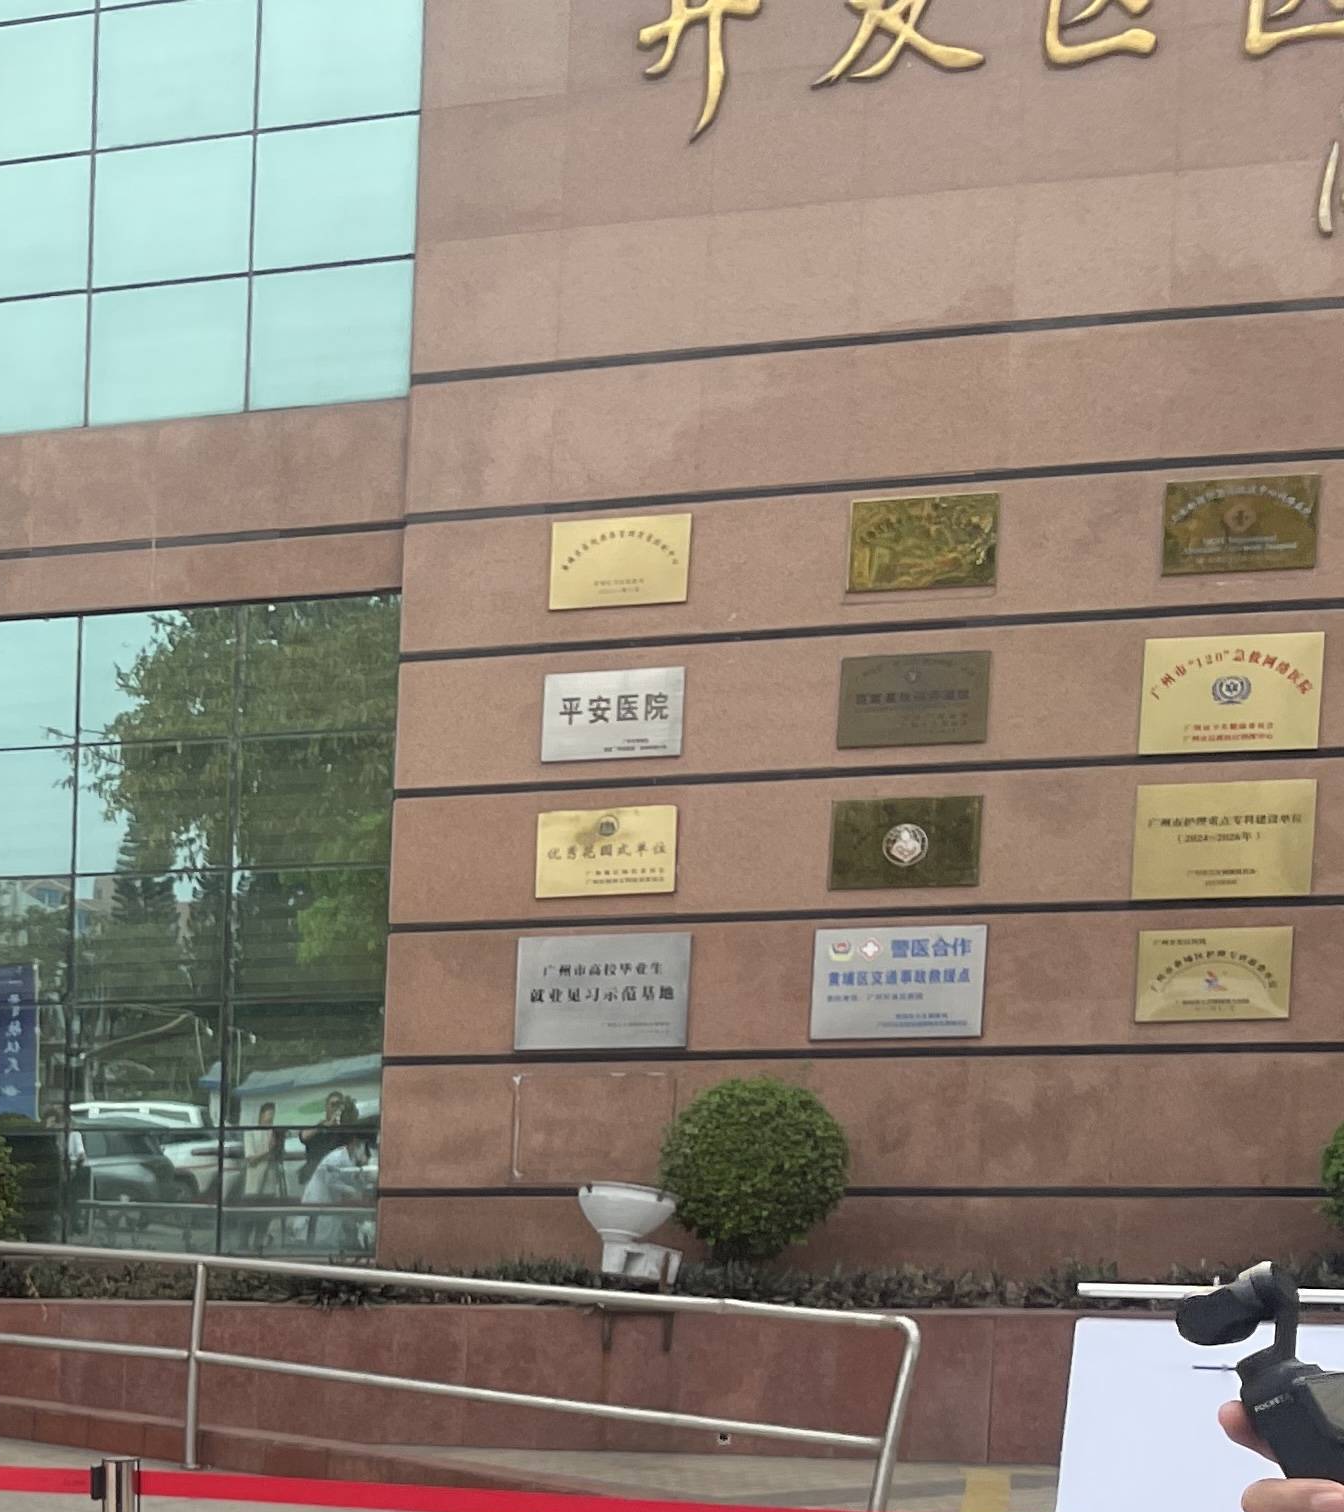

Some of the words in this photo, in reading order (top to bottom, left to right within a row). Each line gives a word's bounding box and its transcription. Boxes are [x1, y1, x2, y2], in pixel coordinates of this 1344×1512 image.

[559, 692, 670, 726] 平安医院
[891, 936, 972, 959] 警医合作
[530, 985, 675, 1003] 就业见习示范基地
